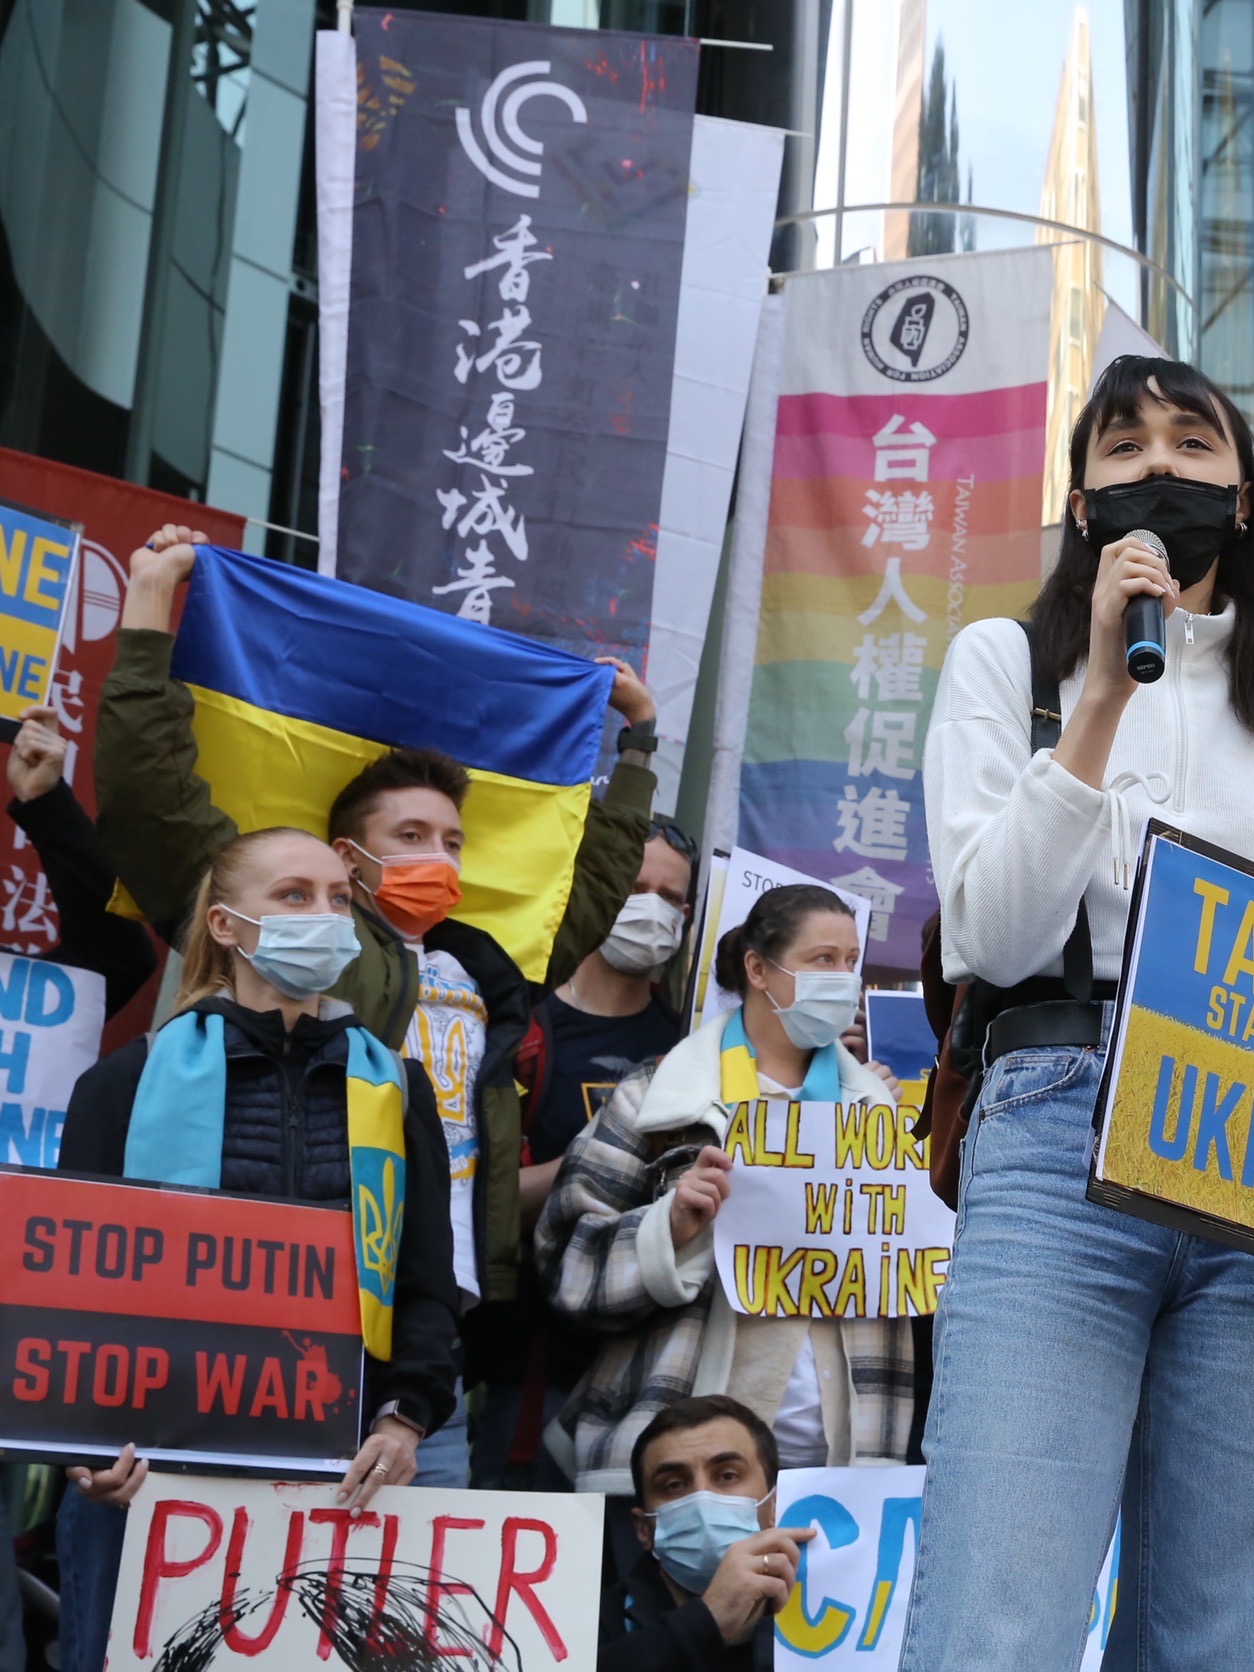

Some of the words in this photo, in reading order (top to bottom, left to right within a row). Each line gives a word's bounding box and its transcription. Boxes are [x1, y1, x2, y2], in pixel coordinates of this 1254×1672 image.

[433, 214, 554, 626] 香港邊城青
[951, 473, 975, 553] TAIWAN
[831, 414, 937, 943] 台灣人權促進會
[724, 1100, 815, 1169] ALL
[23, 1216, 164, 1283] STOP
[185, 1231, 336, 1300] PUTIN
[12, 1337, 170, 1410] STOP
[195, 1350, 327, 1422] WAR
